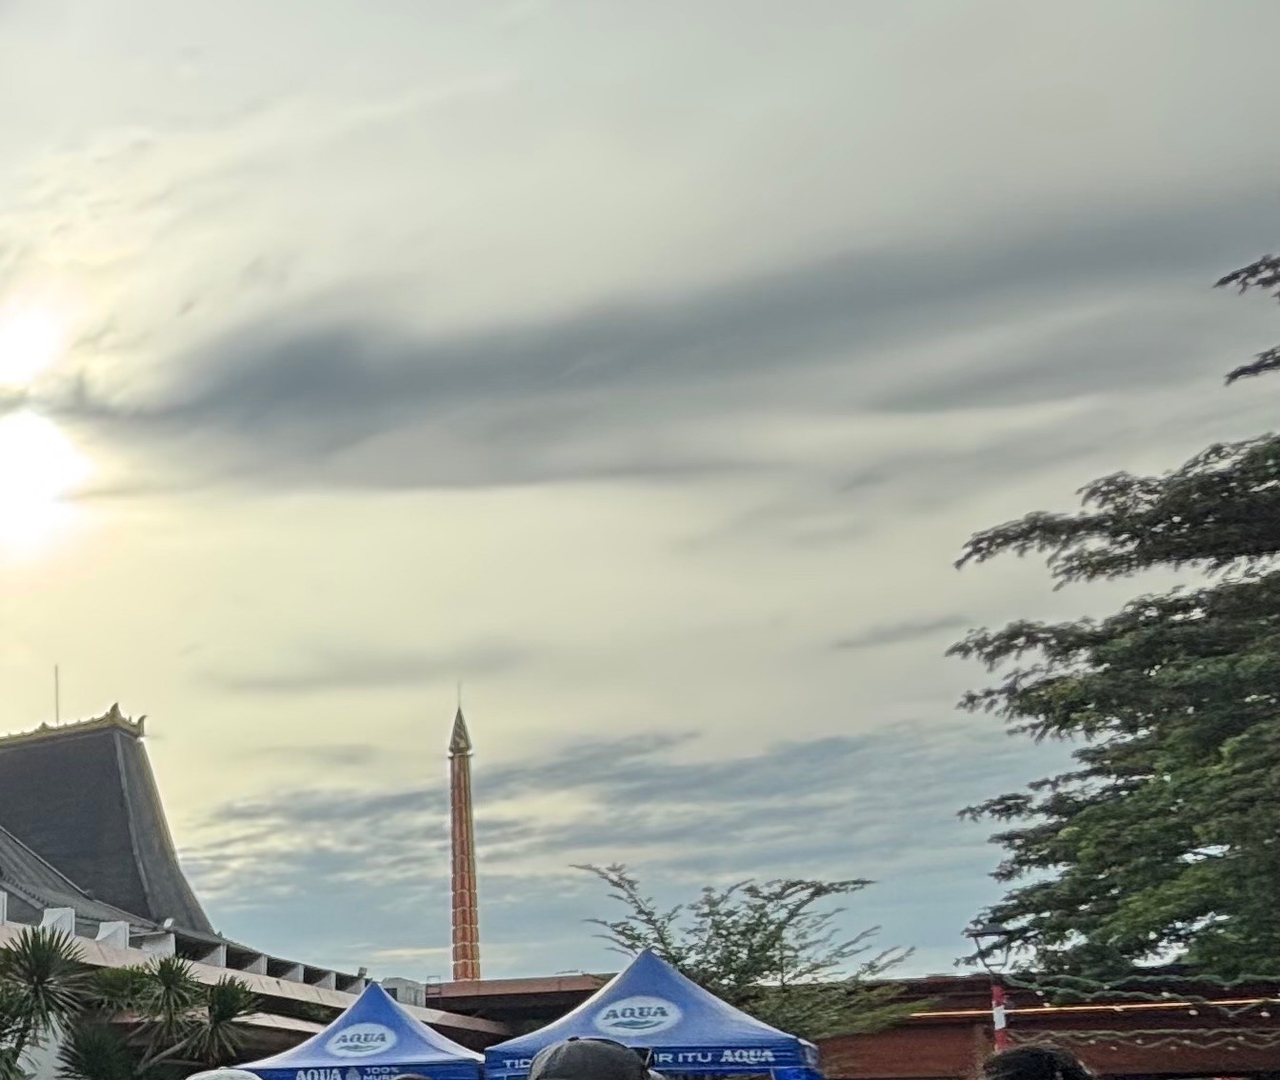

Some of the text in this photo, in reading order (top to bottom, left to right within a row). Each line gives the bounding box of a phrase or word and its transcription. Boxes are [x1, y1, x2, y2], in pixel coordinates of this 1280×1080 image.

[602, 1005, 670, 1021] AQUA
[335, 1032, 388, 1046] AQUA
[502, 1058, 533, 1069] TID
[678, 1052, 712, 1063] ITU
[720, 1049, 775, 1065] AQUA
[364, 1066, 400, 1074] 100%
